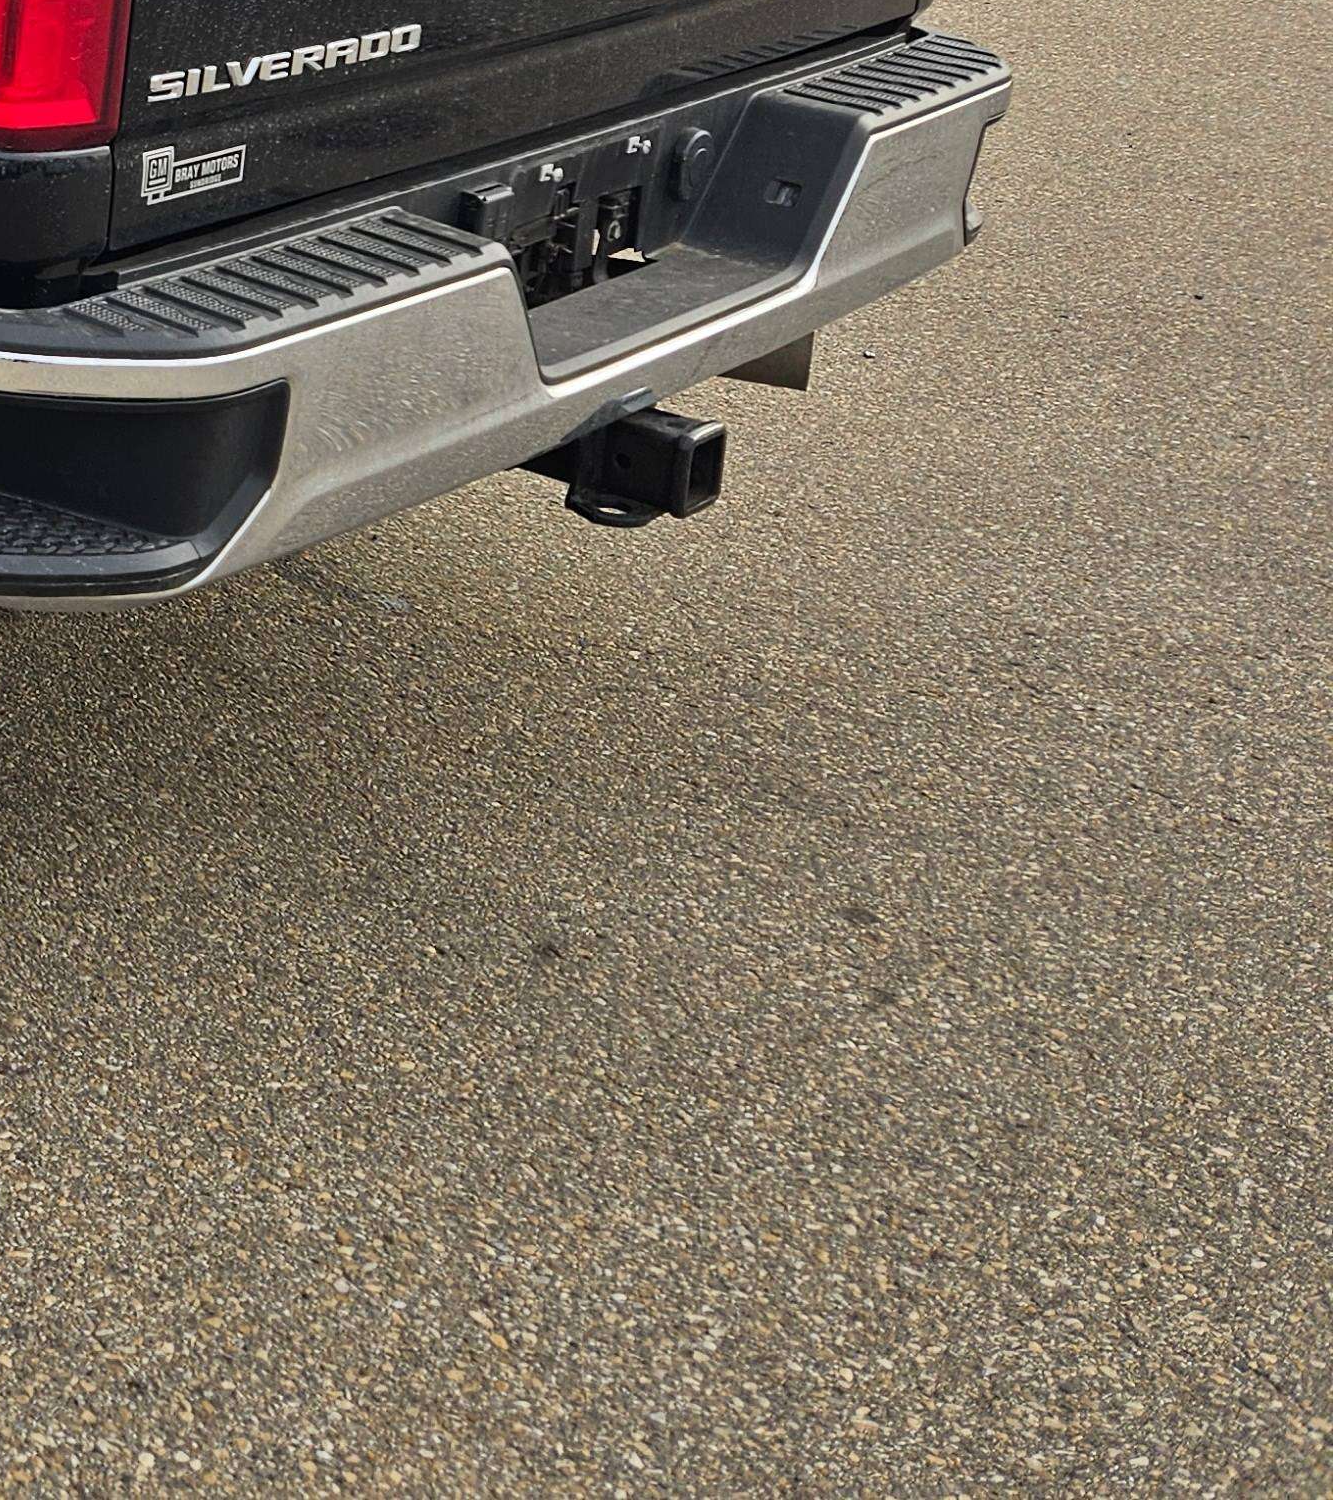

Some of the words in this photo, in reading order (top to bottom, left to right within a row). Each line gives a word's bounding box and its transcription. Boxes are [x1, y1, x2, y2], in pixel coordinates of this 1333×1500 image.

[147, 23, 423, 103] SILVERADO
[149, 157, 168, 179] GM
[174, 164, 201, 183] BRAY
[201, 153, 240, 175] MOTORS
